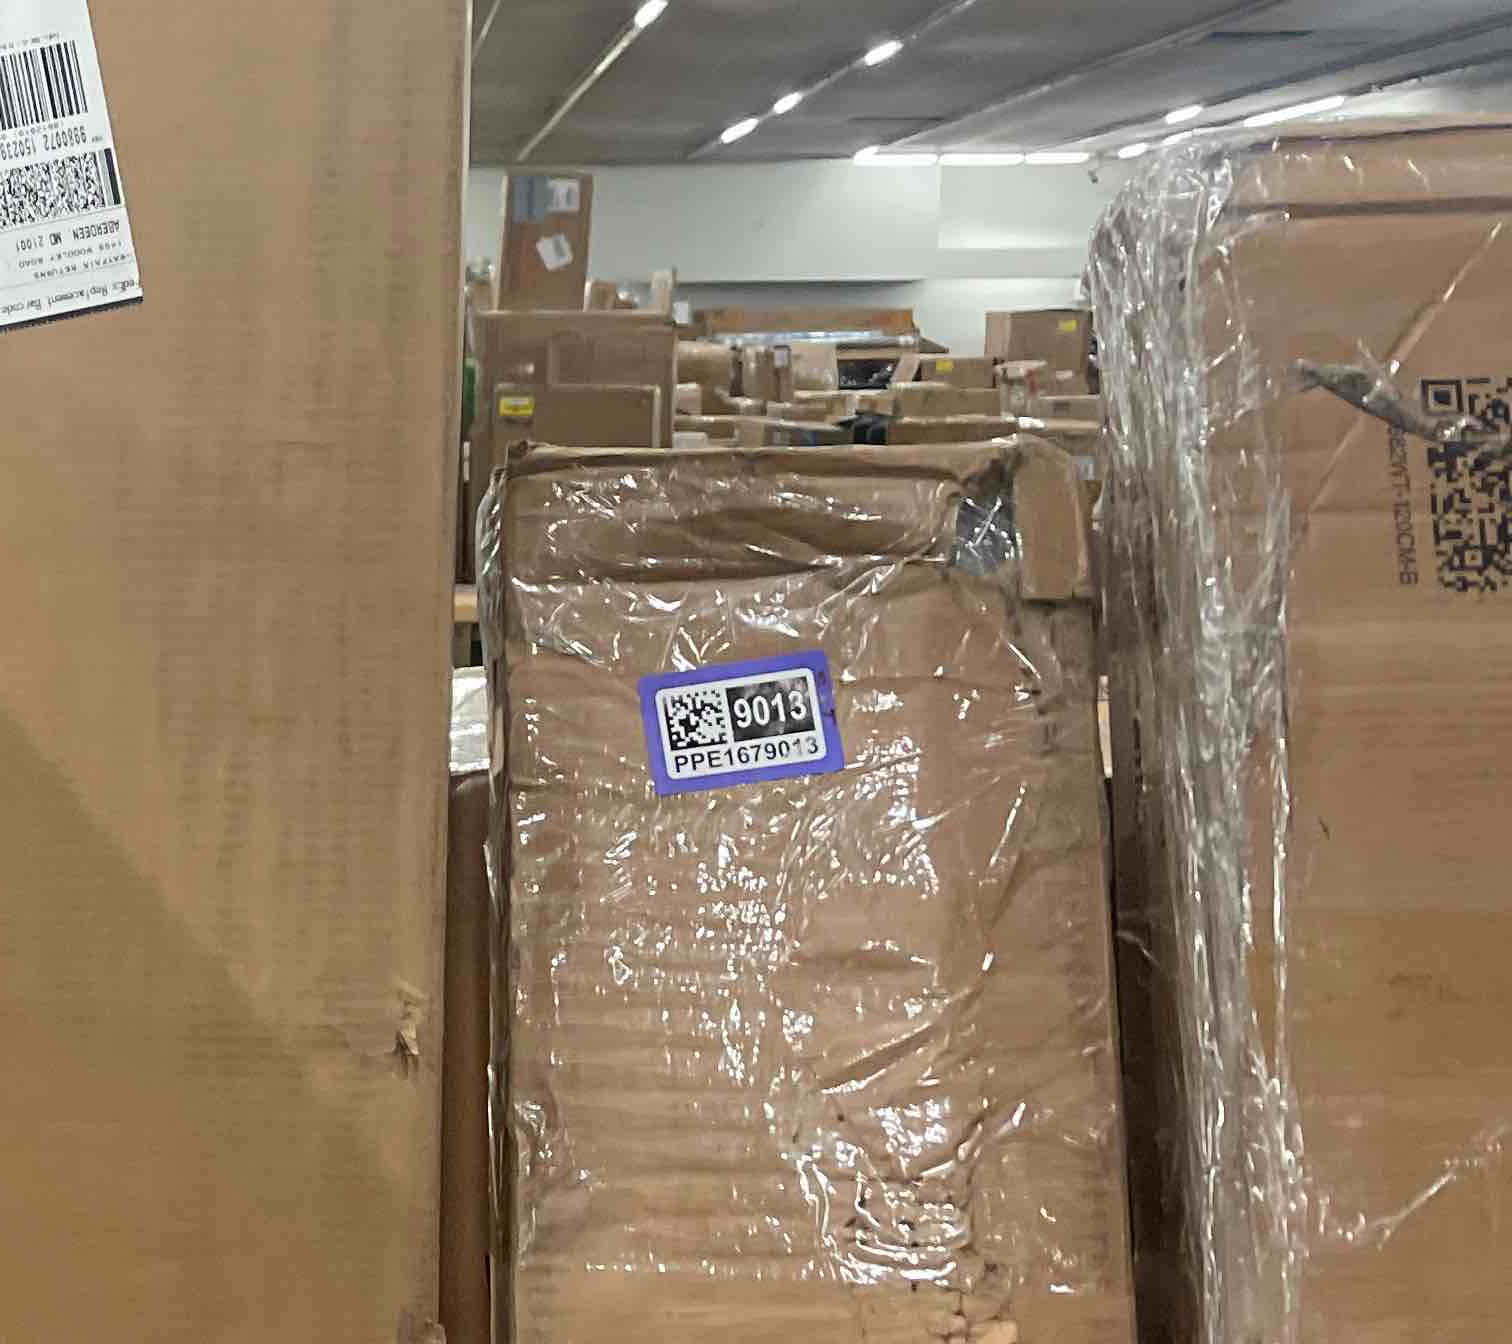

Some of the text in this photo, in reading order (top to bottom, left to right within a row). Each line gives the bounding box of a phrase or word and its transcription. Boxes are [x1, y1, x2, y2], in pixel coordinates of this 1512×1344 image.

[48, 231, 62, 245] MD
[46, 283, 108, 307] Replacement
[733, 690, 808, 729] 9013
[673, 736, 819, 774] PPE1679013
